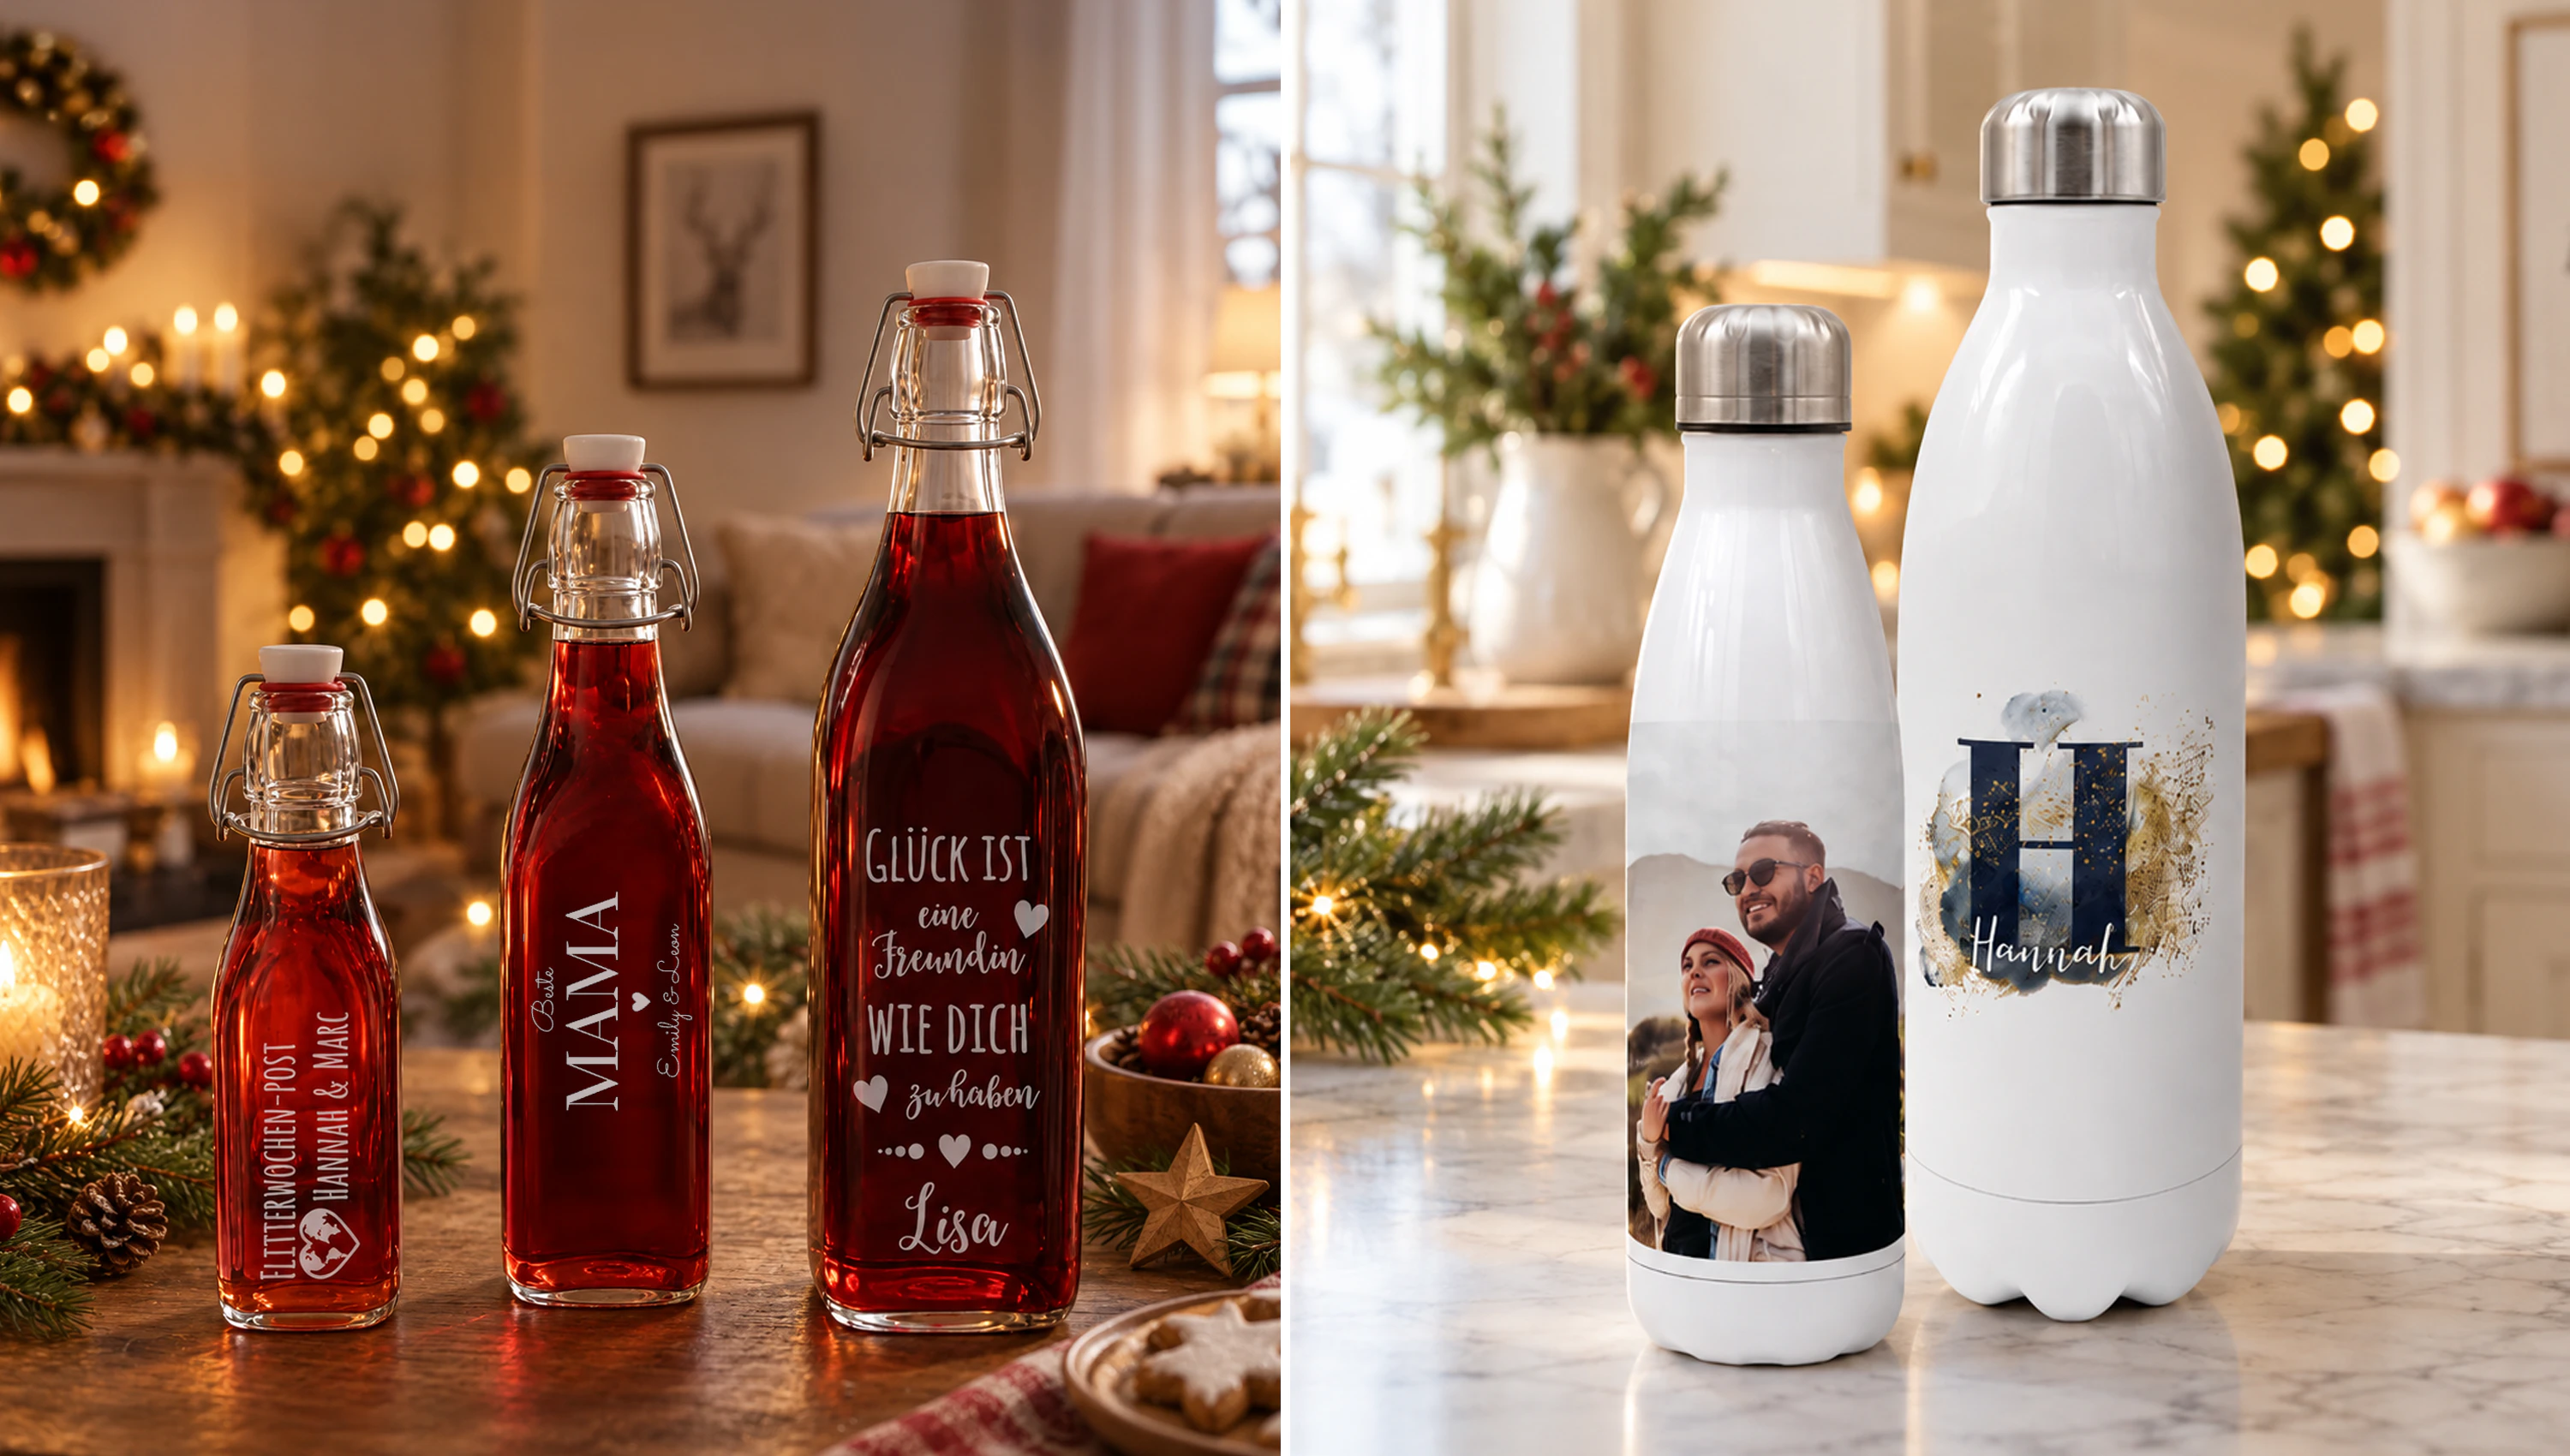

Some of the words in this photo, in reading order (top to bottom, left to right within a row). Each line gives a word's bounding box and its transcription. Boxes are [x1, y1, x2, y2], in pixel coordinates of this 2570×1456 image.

[865, 826, 970, 883] GLÜCK
[981, 834, 1031, 883] IST
[917, 903, 980, 931] eine
[1971, 914, 2133, 975] Hannah
[656, 923, 680, 984] Leon
[871, 929, 1026, 980] Freundin
[530, 966, 554, 1033] Beste
[565, 891, 619, 1112] MAMA
[662, 986, 679, 1005] &
[312, 1011, 349, 1069] MARC
[656, 1010, 693, 1078] Emily
[867, 1003, 933, 1055] WIE
[947, 1003, 1028, 1054] DICH
[313, 1080, 349, 1099] &
[313, 1109, 349, 1201] HANNAH
[899, 1182, 1009, 1255] Lisa
